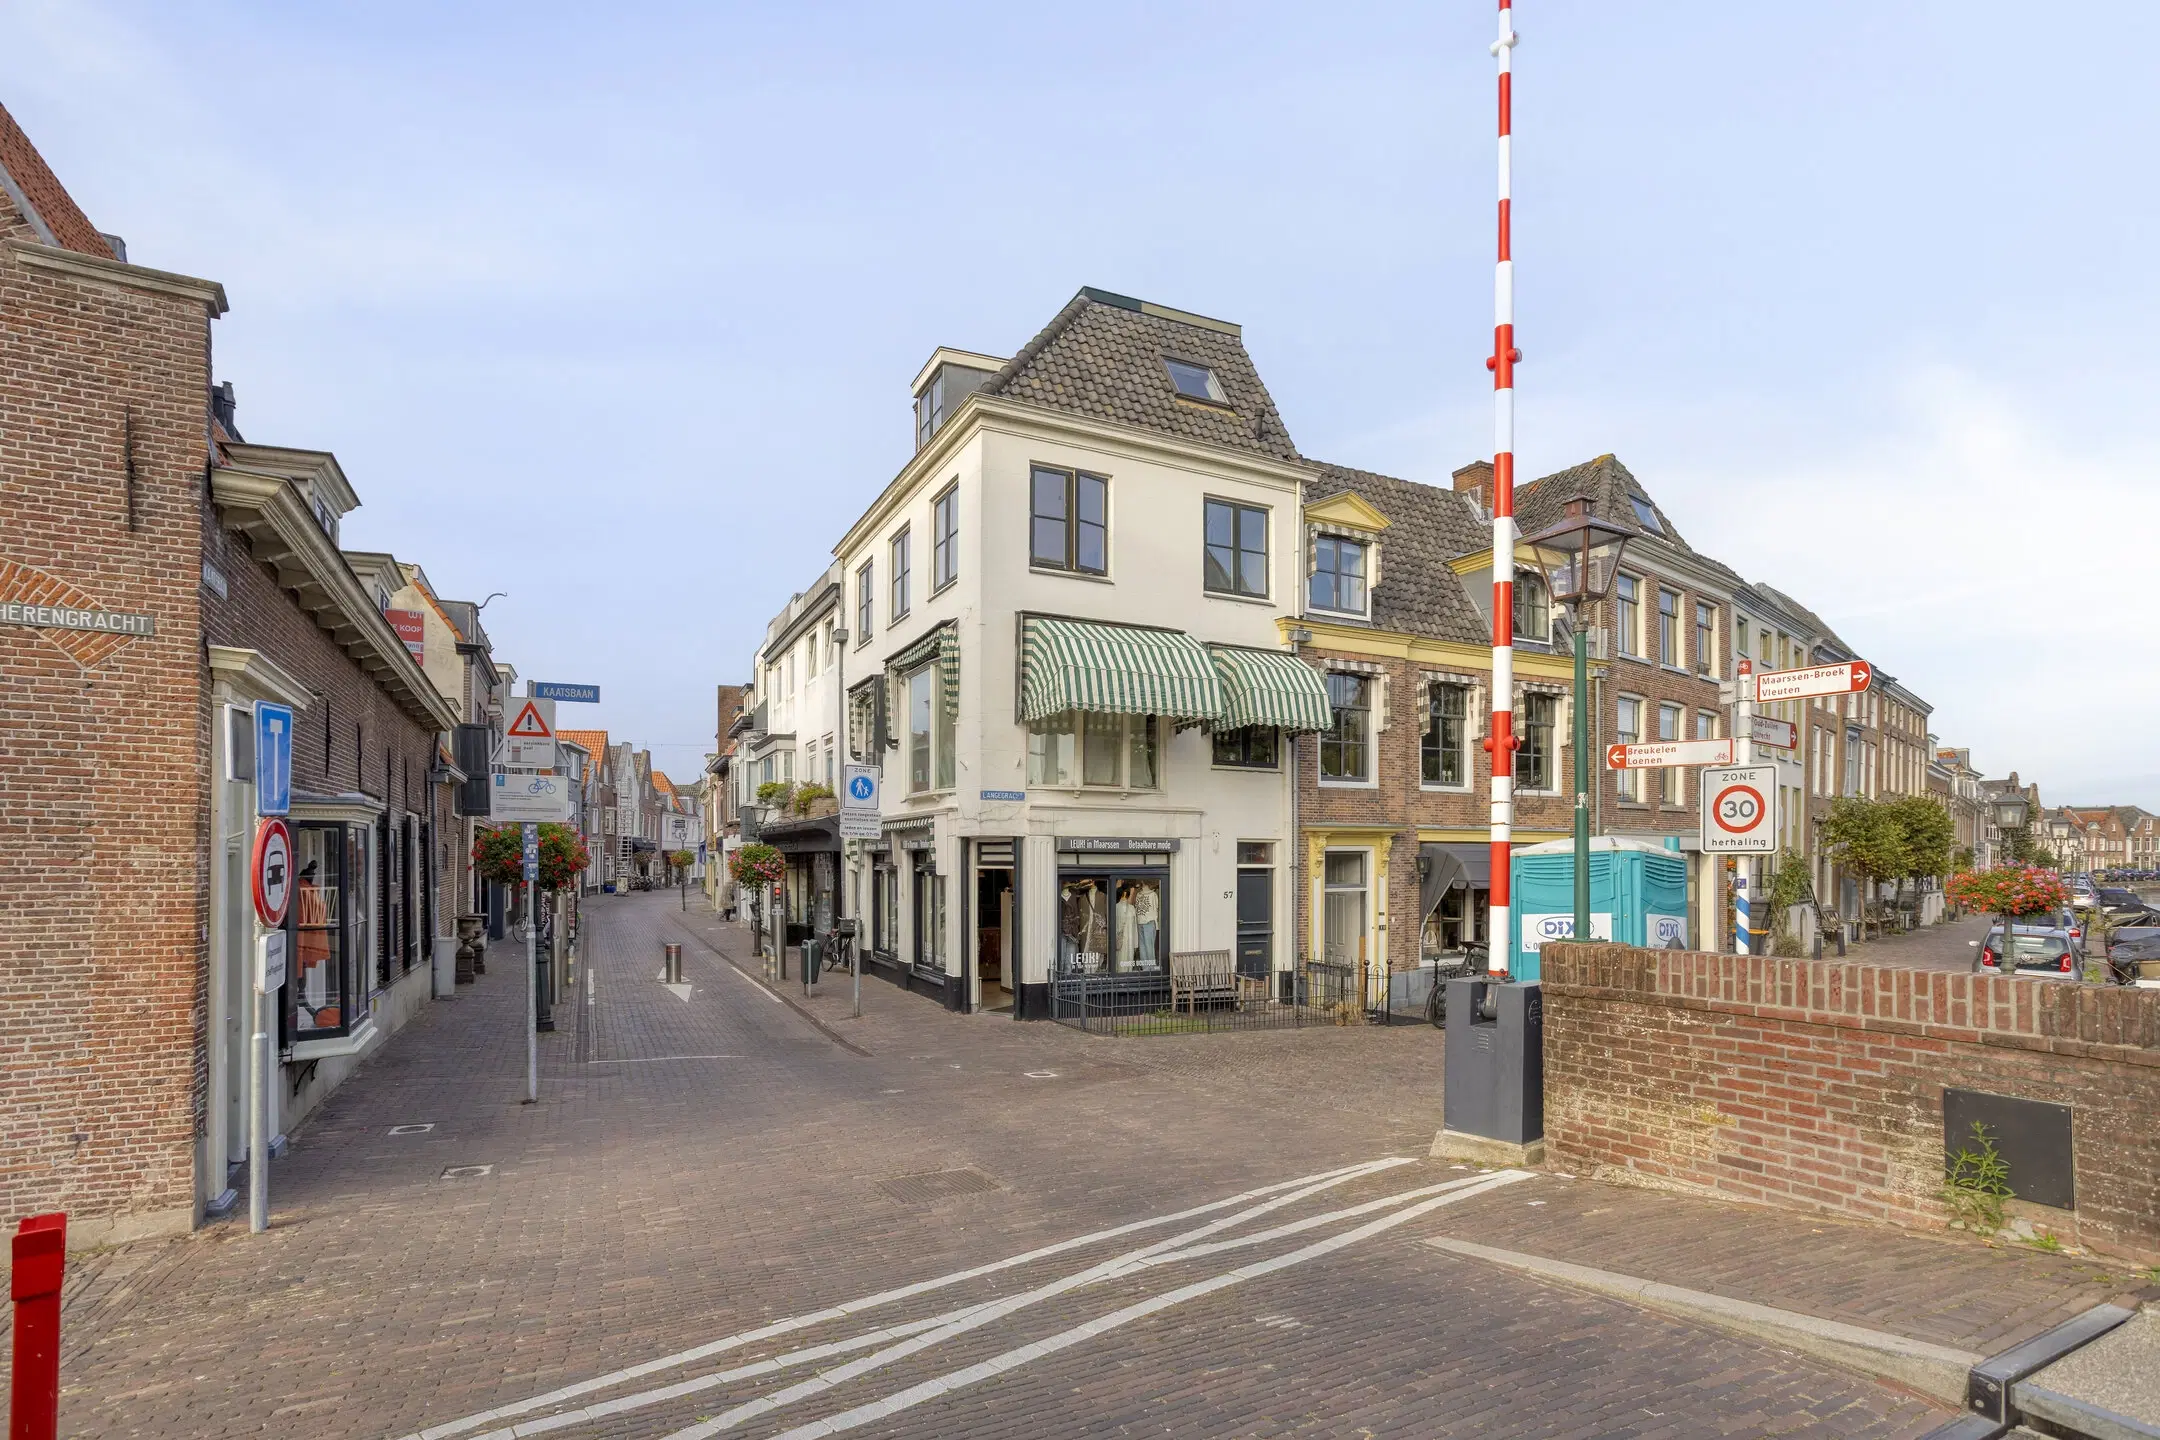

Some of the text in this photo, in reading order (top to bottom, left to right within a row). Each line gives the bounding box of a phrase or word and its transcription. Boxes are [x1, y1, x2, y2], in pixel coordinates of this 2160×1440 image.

[0, 604, 149, 632] HERENGRACHT
[1762, 668, 1845, 685] Maarssen-Broek
[543, 686, 594, 699] KAATSBAAN
[1762, 686, 1800, 697] Vleuten
[1628, 746, 1677, 755] Breukelen
[1628, 757, 1662, 765] Loenen
[1722, 772, 1756, 782] ZONE
[1723, 800, 1755, 818] 30
[1070, 839, 1171, 849] LEUK! in Maarssen Betaalbare mode
[1712, 838, 1766, 848] herhaling
[1224, 891, 1233, 899] 57
[1545, 921, 1575, 935] DiX
[1070, 952, 1099, 965] LEUK!
